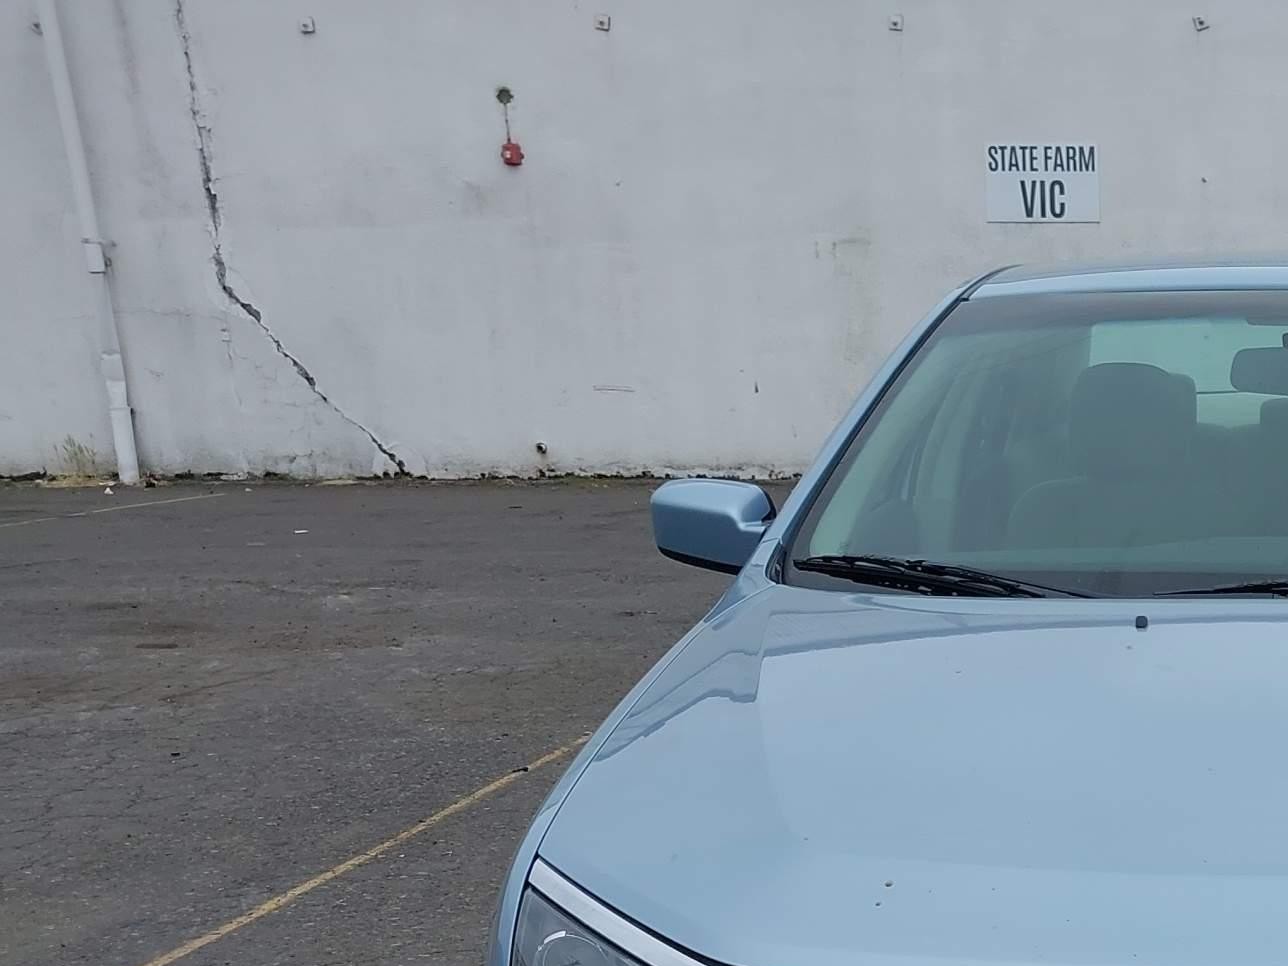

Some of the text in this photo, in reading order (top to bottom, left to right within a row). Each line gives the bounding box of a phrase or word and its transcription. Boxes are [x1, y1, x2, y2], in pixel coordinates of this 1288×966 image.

[989, 146, 1095, 172] STATE FARM
[1019, 180, 1065, 218] VIC
